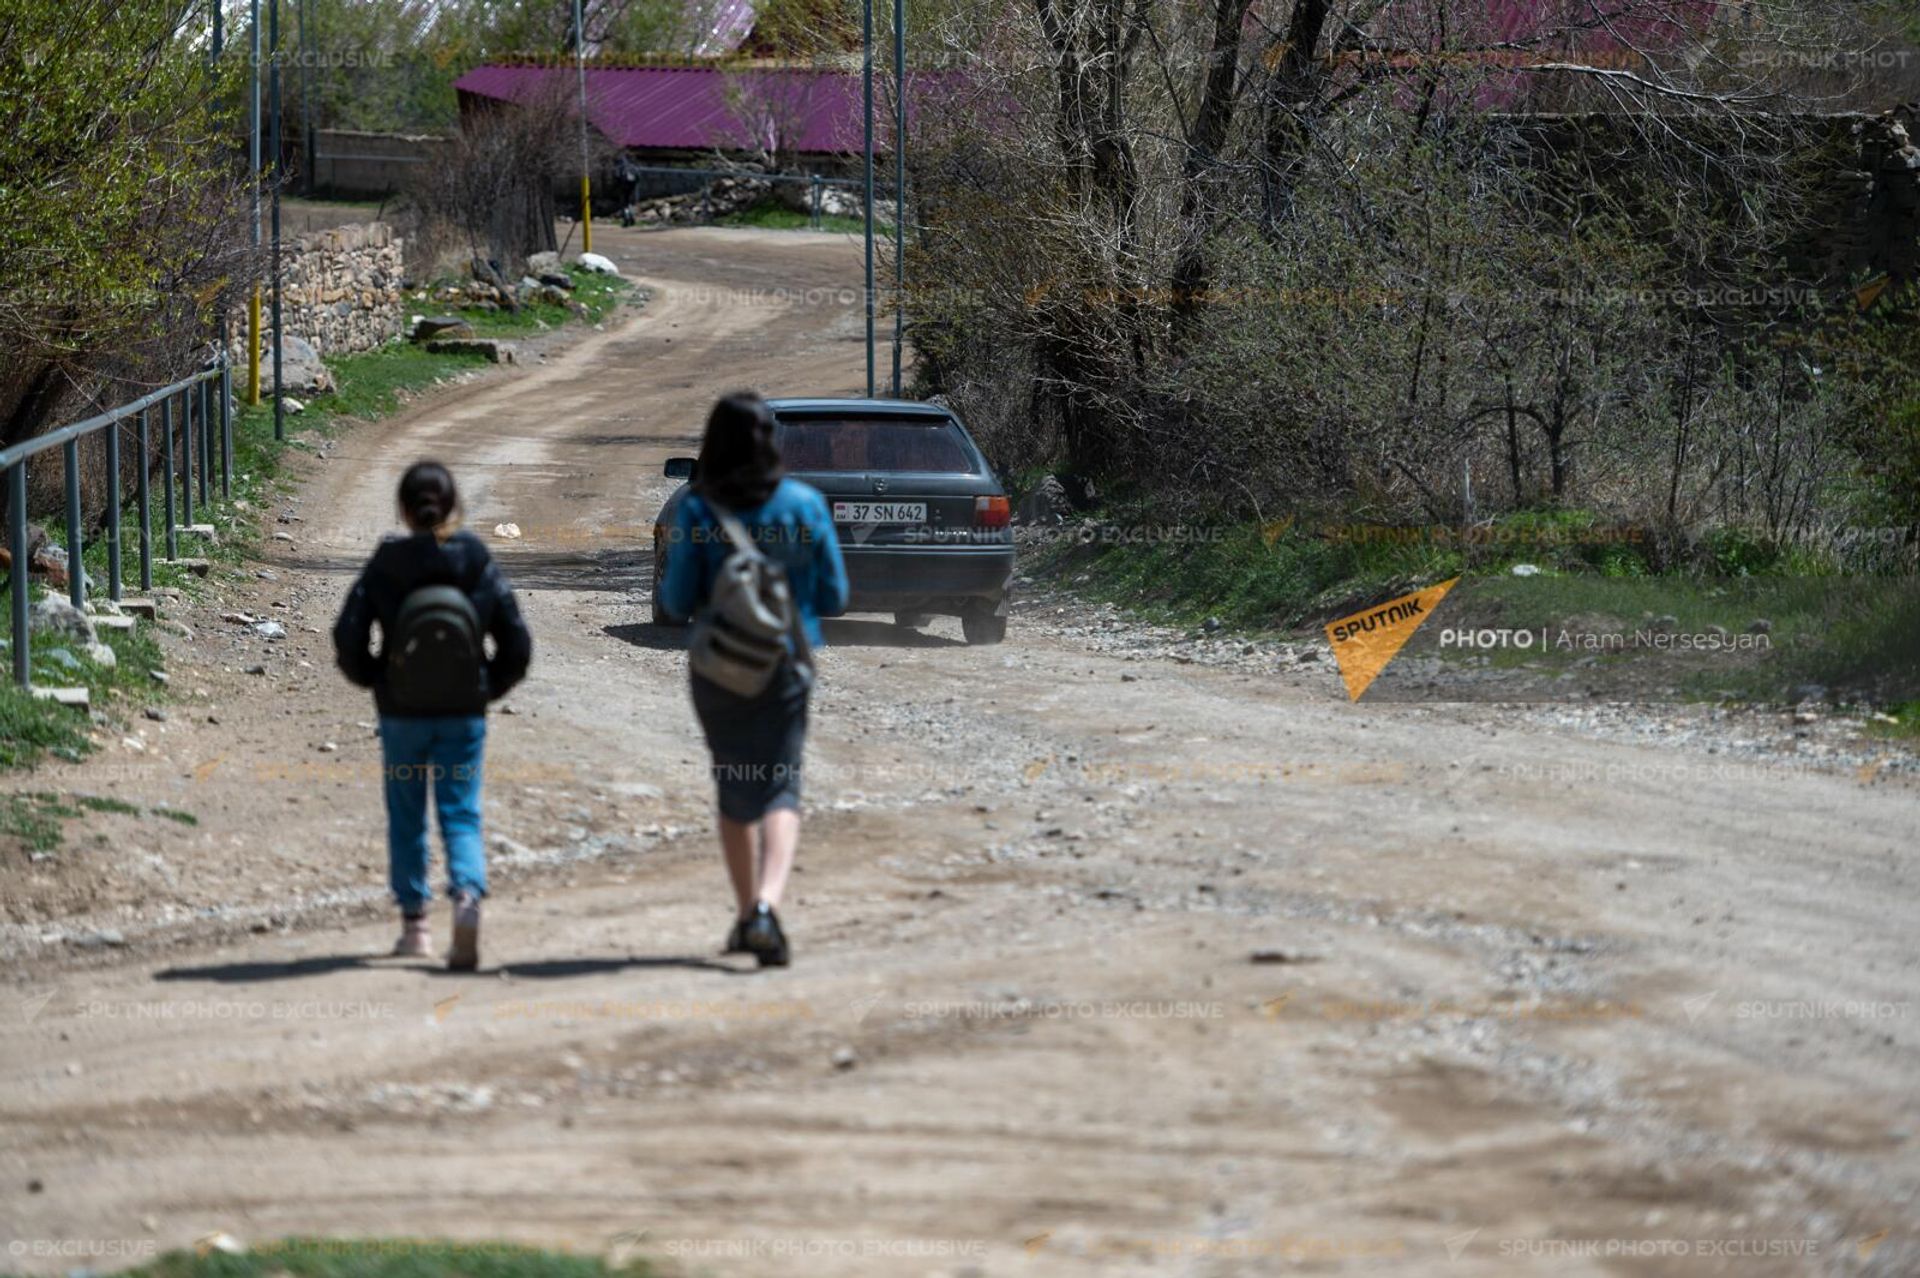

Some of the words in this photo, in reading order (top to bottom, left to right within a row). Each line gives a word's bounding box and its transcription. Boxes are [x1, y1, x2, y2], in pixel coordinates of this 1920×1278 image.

[853, 505, 869, 520] 37
[874, 505, 893, 520] SN
[898, 505, 922, 520] 642
